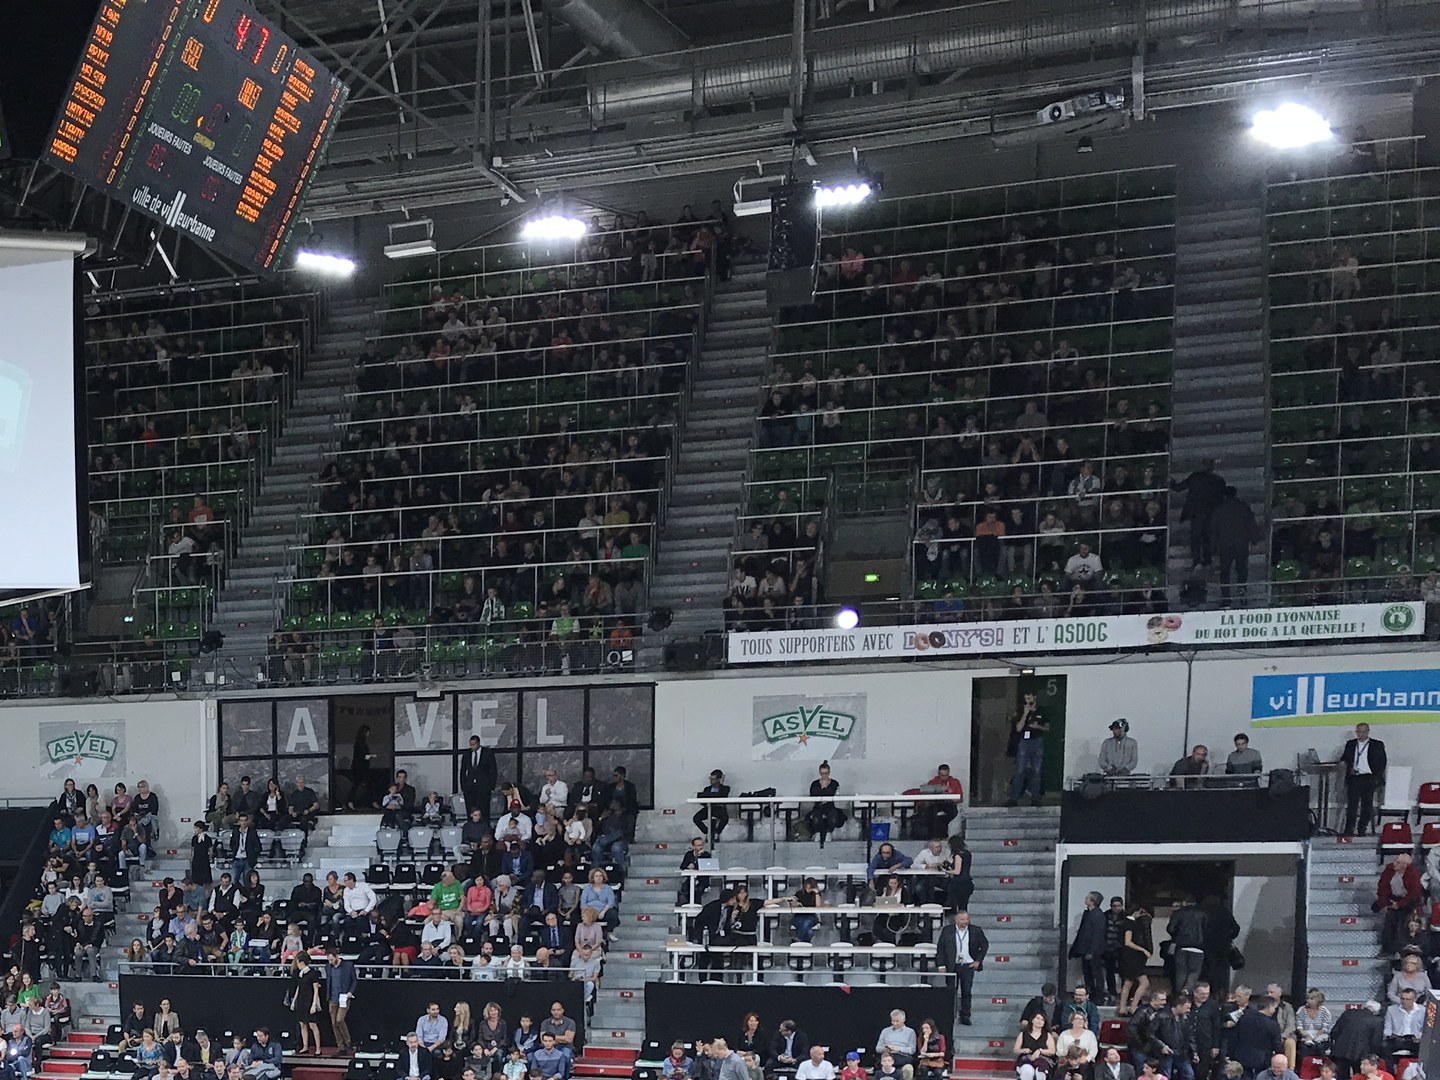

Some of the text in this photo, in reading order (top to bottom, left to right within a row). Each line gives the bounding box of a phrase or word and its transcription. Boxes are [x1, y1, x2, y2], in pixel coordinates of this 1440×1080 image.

[148, 121, 172, 144] JOUEURS
[171, 134, 193, 155] FAUTES
[203, 154, 244, 186] JOUEURS FAUTES
[132, 185, 216, 242] ville de villeurbanne
[1195, 627, 1211, 639] DU
[1213, 626, 1238, 639] HOT
[1242, 625, 1268, 638] DOG
[1272, 625, 1280, 636] A
[1282, 624, 1297, 636] LA
[1301, 621, 1358, 635] QUENELLE
[1221, 609, 1341, 625] LA FOOD LYONNAISE
[740, 637, 772, 656] TOUS
[779, 633, 855, 654] SUPPORTERS
[862, 632, 894, 651] AVEC
[1013, 626, 1031, 644] ET
[1054, 622, 1108, 644] ASDOG
[1047, 678, 1057, 697] 5
[772, 704, 845, 735] ASVEL
[54, 729, 110, 757] ASVEL
